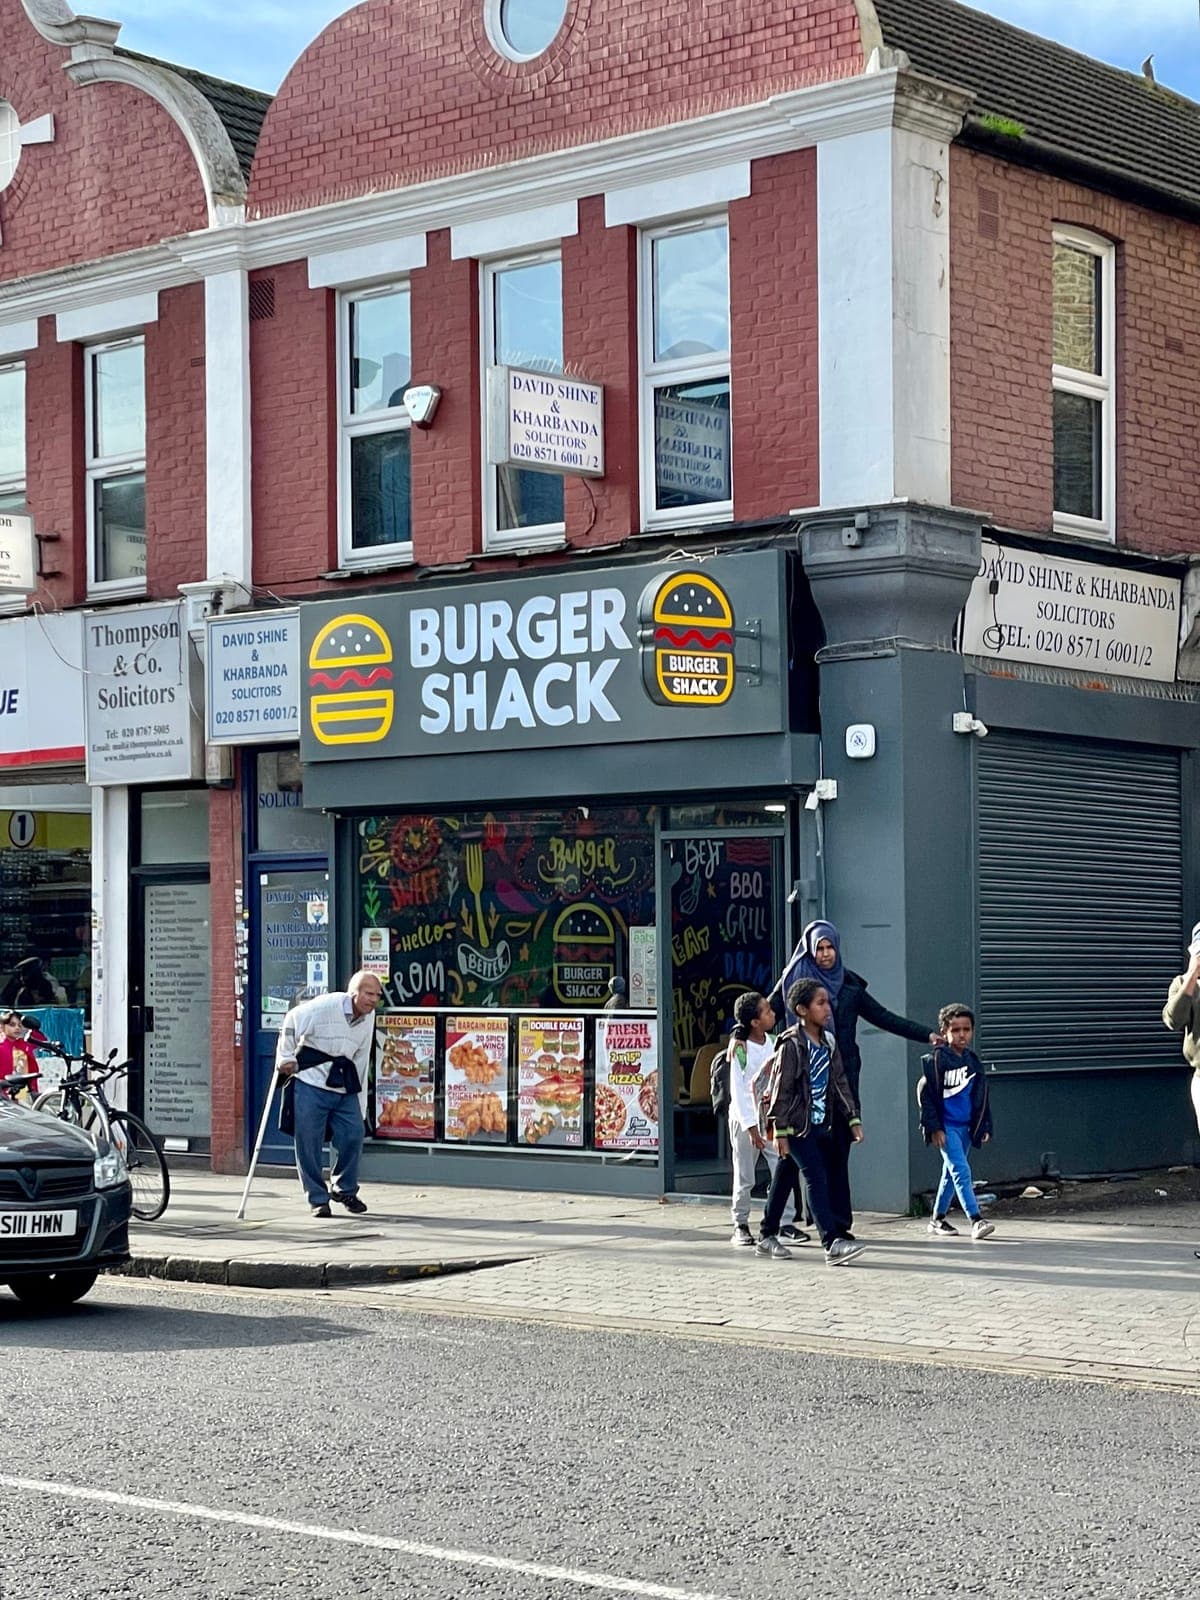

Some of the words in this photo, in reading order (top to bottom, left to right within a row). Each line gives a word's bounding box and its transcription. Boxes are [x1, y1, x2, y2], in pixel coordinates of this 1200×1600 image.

[513, 376, 554, 395] DAVID
[558, 385, 598, 405] SHINE
[551, 400, 560, 414] &
[513, 409, 598, 436] KHARBANDA
[525, 430, 586, 449] SOLICITORS
[514, 443, 531, 457] 020
[534, 446, 556, 461] 8571
[561, 451, 583, 465] 6001
[978, 557, 1024, 584] DAVID
[1028, 565, 1072, 593] SHINE
[1076, 581, 1086, 595] &
[1090, 576, 1176, 611] KHARBANDA
[1036, 600, 1116, 630] SOLICITORS
[91, 622, 179, 648] Thompson
[409, 588, 632, 668] BURGER
[222, 632, 254, 648] DAVID
[257, 628, 288, 644] SHINE
[998, 624, 1030, 648] TEL:
[1036, 630, 1062, 653] 020
[1066, 635, 1100, 659] 8571
[1106, 640, 1152, 667] 6001/2
[114, 654, 128, 677] &
[134, 652, 162, 675] Co.
[252, 649, 259, 661] &
[224, 664, 288, 681] KHARBANDA
[669, 655, 720, 675] BURGER
[232, 685, 282, 700] SOLICITORS
[672, 677, 719, 696] SHACK
[98, 684, 175, 710] Solicitors
[420, 659, 621, 734] SHACK
[216, 711, 234, 724] 020
[236, 709, 260, 722] 8571
[263, 706, 298, 720] 6001/2
[106, 730, 118, 740] Tel:
[18, 814, 26, 840] 1
[547, 837, 620, 876] BURGER
[730, 871, 763, 900] BBQ
[266, 891, 294, 904] DAVID
[298, 890, 328, 904] SHINE
[292, 909, 300, 918] &
[726, 903, 768, 944] GRILL
[266, 938, 328, 949] SOLICITORS
[671, 926, 710, 968] EAT
[564, 967, 603, 980] BURGER
[566, 985, 601, 998] SHACK
[384, 1016, 412, 1026] SPECIAL
[414, 1016, 434, 1026] DEALS
[458, 1020, 486, 1030] BARGAIN
[486, 1020, 507, 1031] DEALS
[530, 1020, 558, 1030] DOUBLE
[560, 1021, 582, 1031] DEALS
[608, 1023, 648, 1036] FRESH
[482, 1042, 506, 1050] WINGS
[486, 1034, 506, 1042] SPICY
[606, 1036, 652, 1050] PIZZAS
[610, 1052, 618, 1062] 2
[608, 1074, 644, 1086] PIZZAS
[944, 1066, 968, 1086] NIKE
[448, 1091, 478, 1100] CHICKEN
[31, 1214, 63, 1233] HWN
